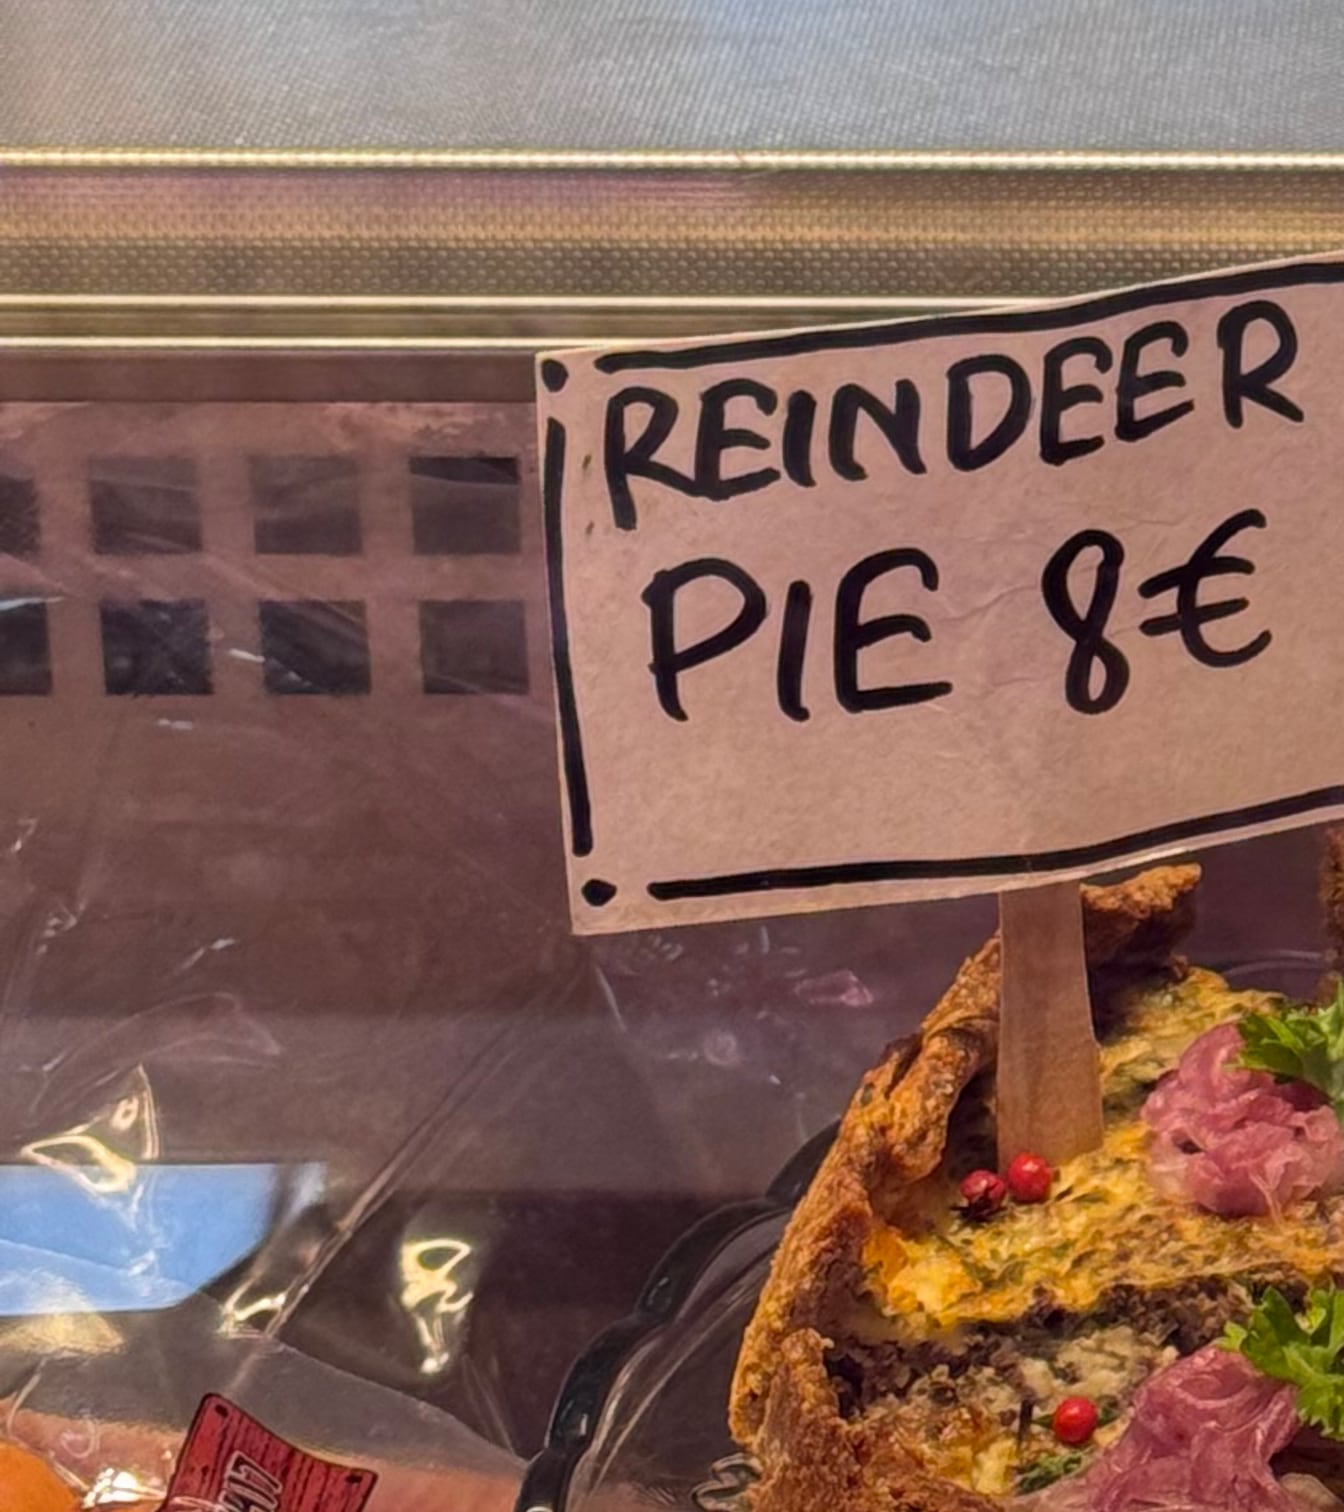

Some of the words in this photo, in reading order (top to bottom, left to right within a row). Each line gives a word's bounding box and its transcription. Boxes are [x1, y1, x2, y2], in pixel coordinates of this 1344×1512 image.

[604, 300, 1304, 530] REINDEER
[641, 547, 953, 722] PIE
[1041, 508, 1273, 716] 8€
